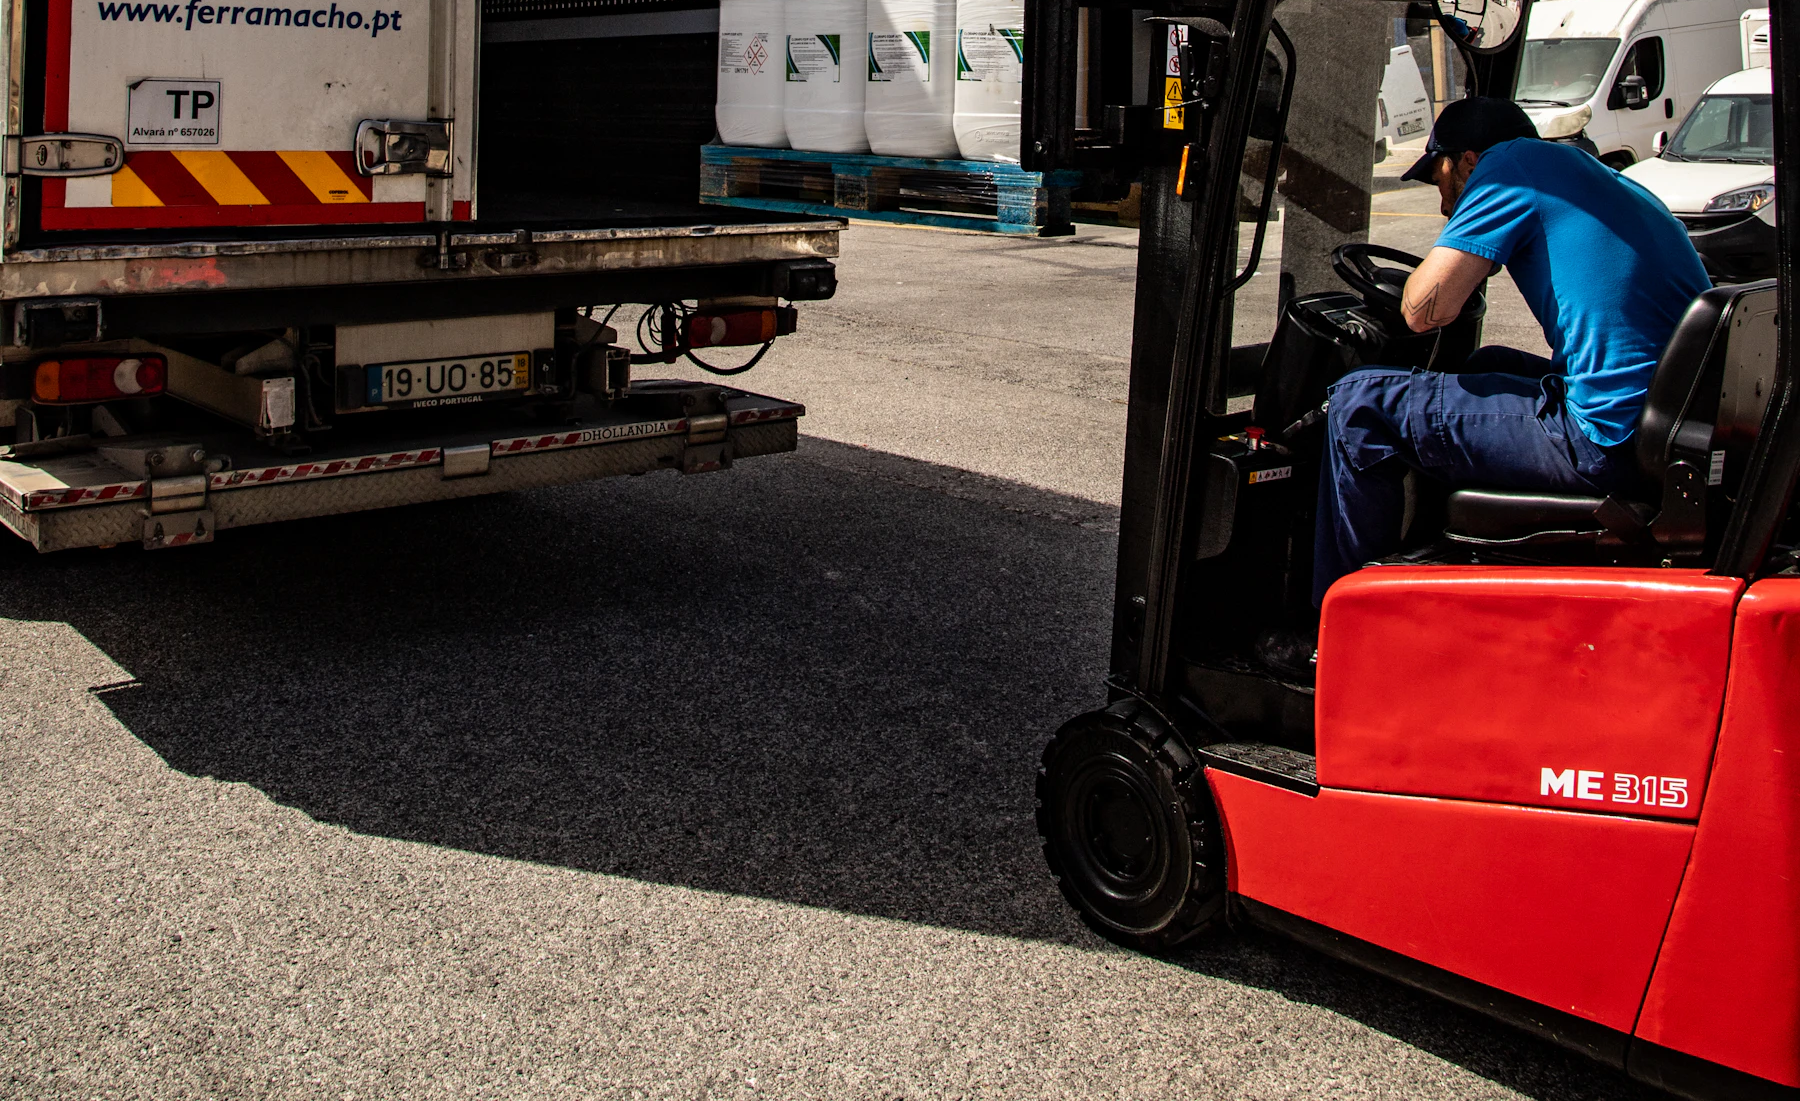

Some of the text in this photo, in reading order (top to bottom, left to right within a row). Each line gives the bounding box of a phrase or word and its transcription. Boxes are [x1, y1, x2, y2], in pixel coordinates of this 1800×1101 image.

[165, 89, 215, 120] TP
[1393, 107, 1426, 118] PEUGEOT
[132, 127, 165, 137] Alvará
[180, 127, 215, 137] 657026
[517, 357, 526, 368] 18
[413, 395, 483, 408] IVECO PORTUGAL
[582, 422, 667, 442] DHOLLANDIA
[1540, 767, 1689, 809] ME 315
